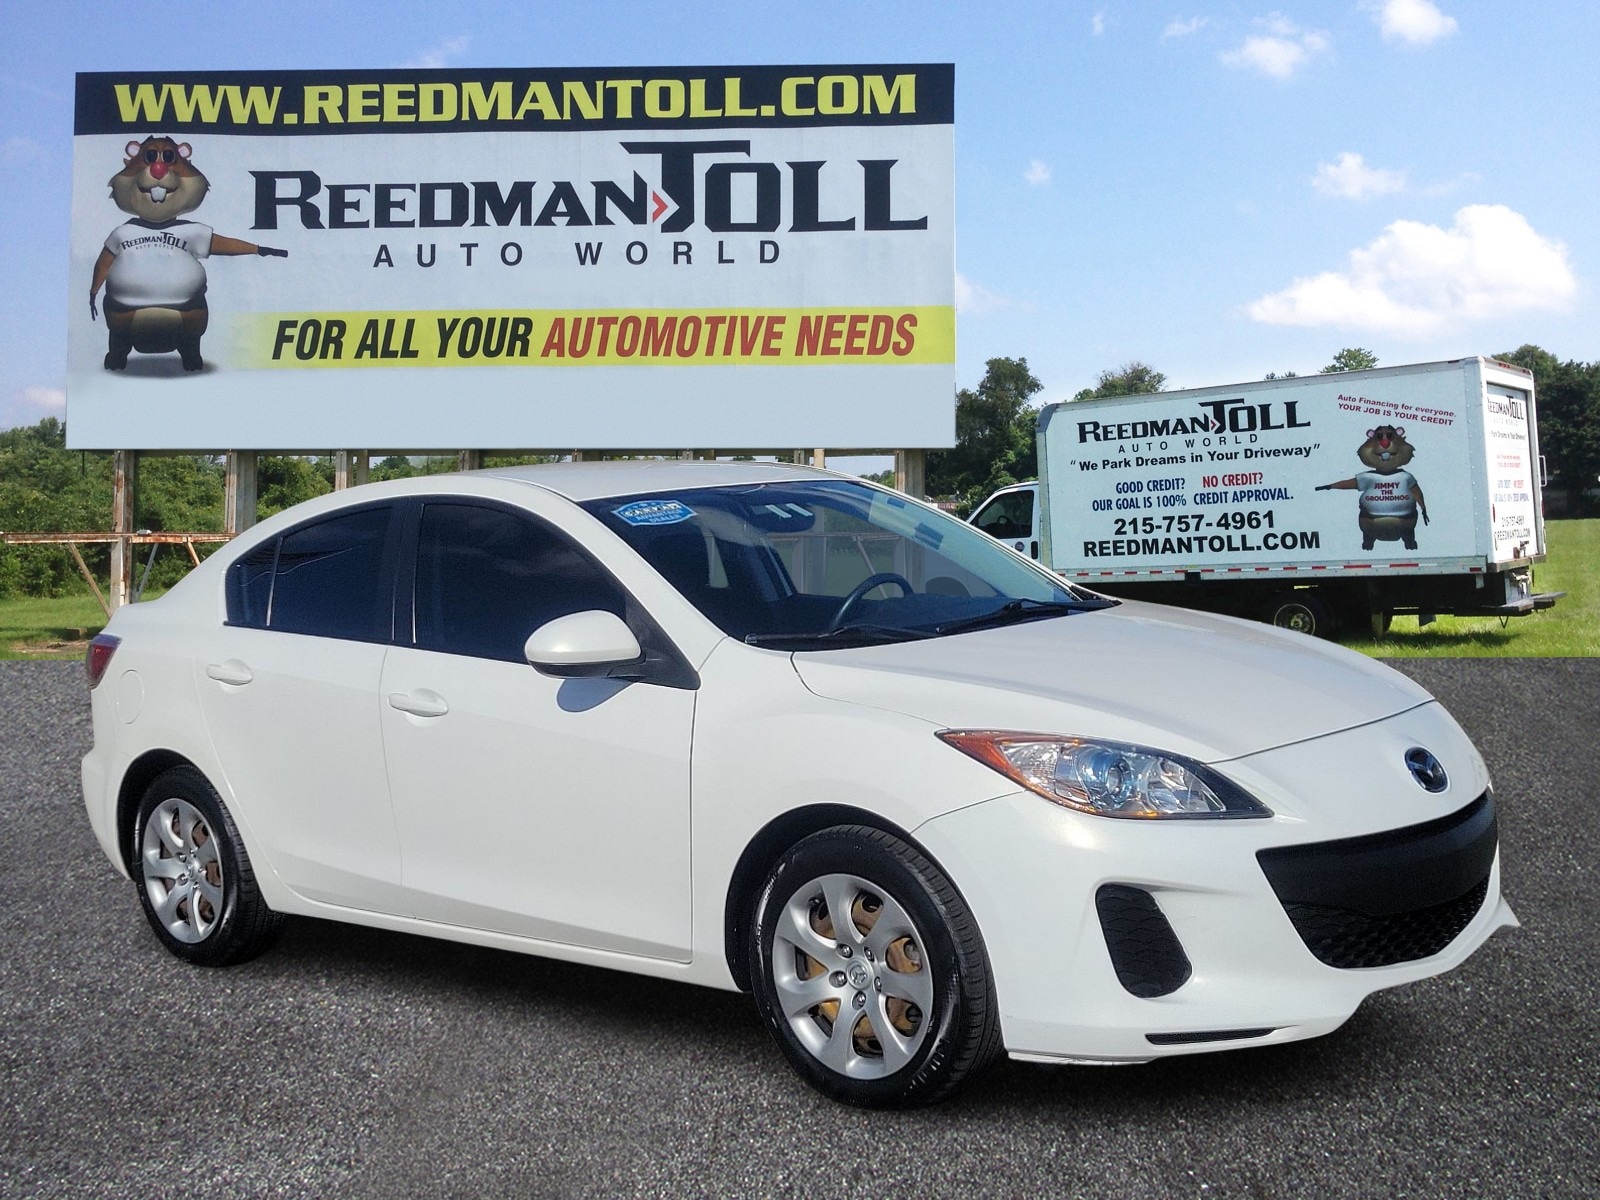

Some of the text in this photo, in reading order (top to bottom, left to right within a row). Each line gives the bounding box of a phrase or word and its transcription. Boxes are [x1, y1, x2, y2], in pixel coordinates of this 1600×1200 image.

[114, 74, 916, 125] WWW.REEDMANTOLL.COM
[373, 240, 780, 268] AUTO WORLD
[272, 314, 918, 360] FOR ALL YOUR AUTOMOTIVE NEEDS
[1337, 394, 1457, 418] Auto Financing for everyone.
[1338, 403, 1361, 412] YOUR
[1363, 407, 1381, 415] JOB
[1394, 411, 1419, 421] YOUR
[1420, 415, 1454, 426] CREDIT
[1118, 433, 1258, 454] AUTO WORLD
[1102, 458, 1131, 469] Park
[1136, 455, 1186, 467] Dreams
[1190, 452, 1203, 463] in
[1207, 450, 1239, 461] Your
[1116, 472, 1264, 494] GOOD CREDIT? NO CREDIT?
[1092, 487, 1294, 512] OUR GOAL IS 100% CREDIT APPROVAL.
[1114, 510, 1275, 536] 215-757-4961
[1083, 531, 1321, 558] REEDMANTOLL.COM
